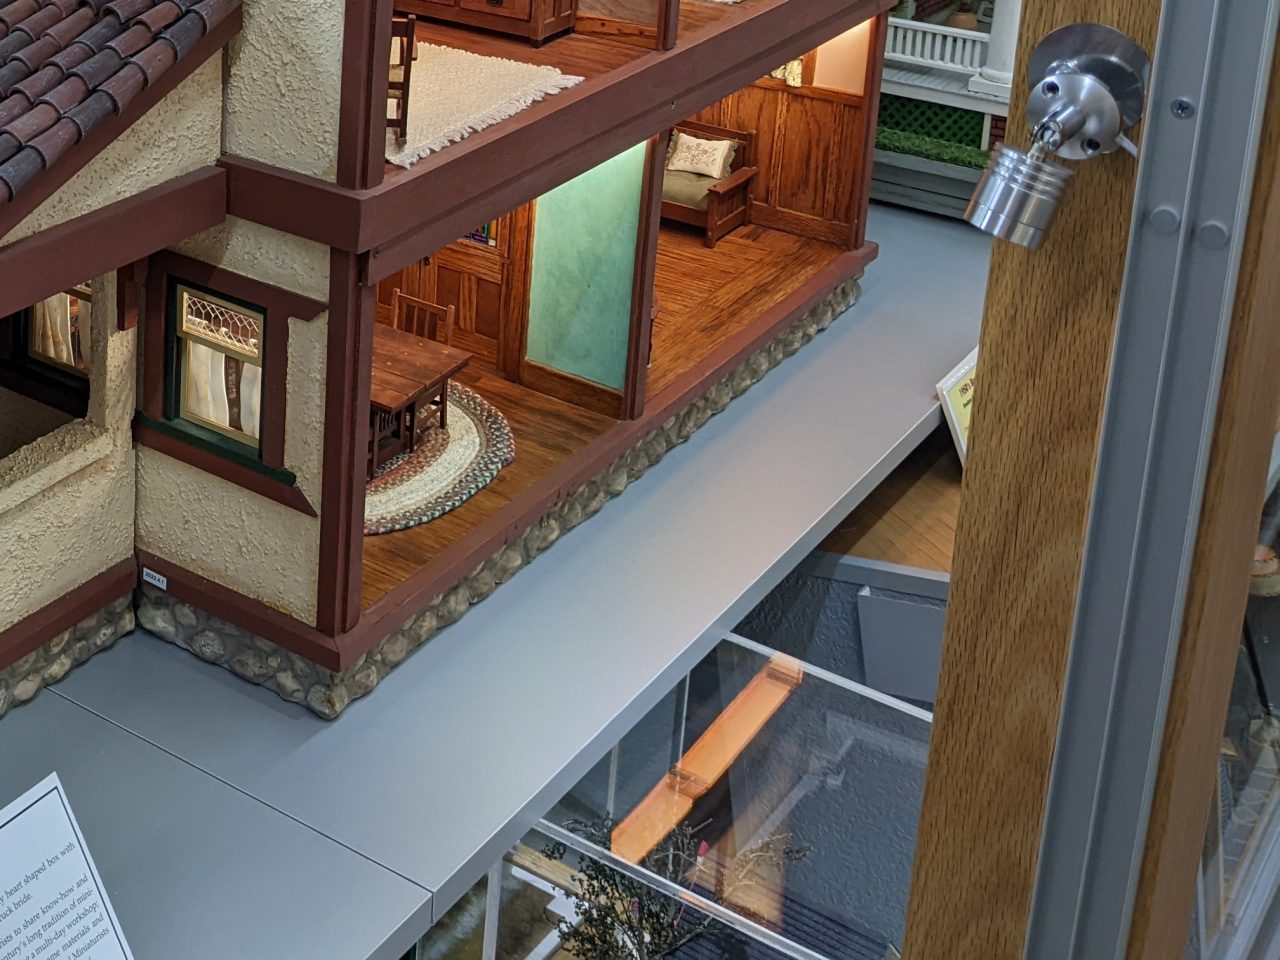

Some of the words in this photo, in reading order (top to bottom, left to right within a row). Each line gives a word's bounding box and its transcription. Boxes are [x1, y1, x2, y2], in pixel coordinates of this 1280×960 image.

[5, 880, 23, 900] heart
[23, 862, 47, 886] shaped
[46, 853, 60, 868] box
[60, 841, 75, 857] with
[13, 893, 33, 912] bride.
[14, 926, 22, 937] to
[22, 912, 40, 930] share
[40, 885, 75, 916] know-how
[76, 873, 88, 888] and
[26, 929, 43, 946] long
[42, 907, 73, 932] tradition
[69, 897, 78, 911] of
[77, 888, 93, 906] mini-
[35, 927, 66, 955] multi-day
[62, 925, 91, 952] materials
[92, 913, 104, 928] and
[71, 927, 110, 960] Miniaturists
